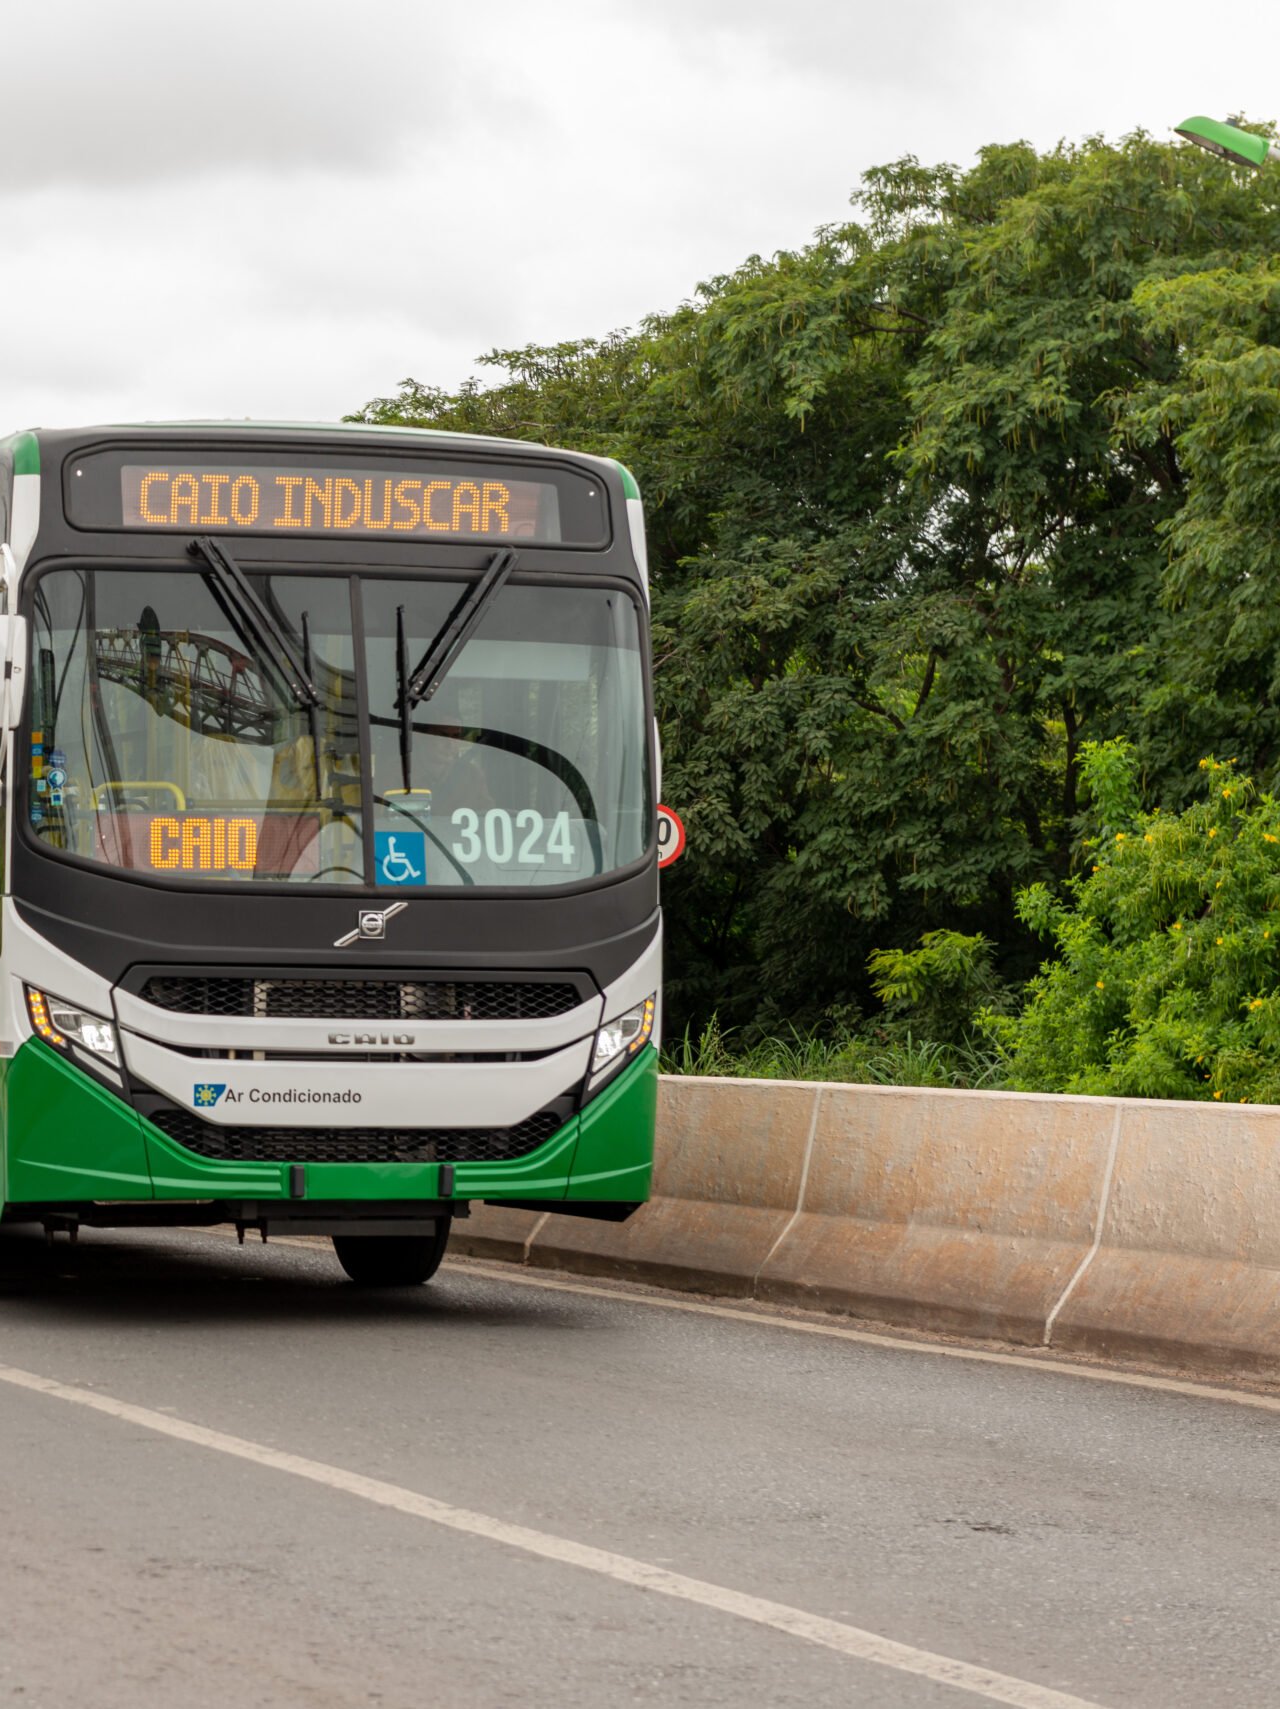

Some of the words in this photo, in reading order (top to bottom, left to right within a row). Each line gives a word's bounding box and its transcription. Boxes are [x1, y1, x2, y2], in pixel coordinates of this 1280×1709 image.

[140, 472, 259, 525] CAIO
[274, 476, 510, 532] INDUSCAR
[150, 818, 257, 869] CAIO
[451, 807, 575, 865] 3024
[327, 1032, 415, 1045] CAIO
[225, 1088, 244, 1103] Ar
[249, 1088, 362, 1103] Condicionado
